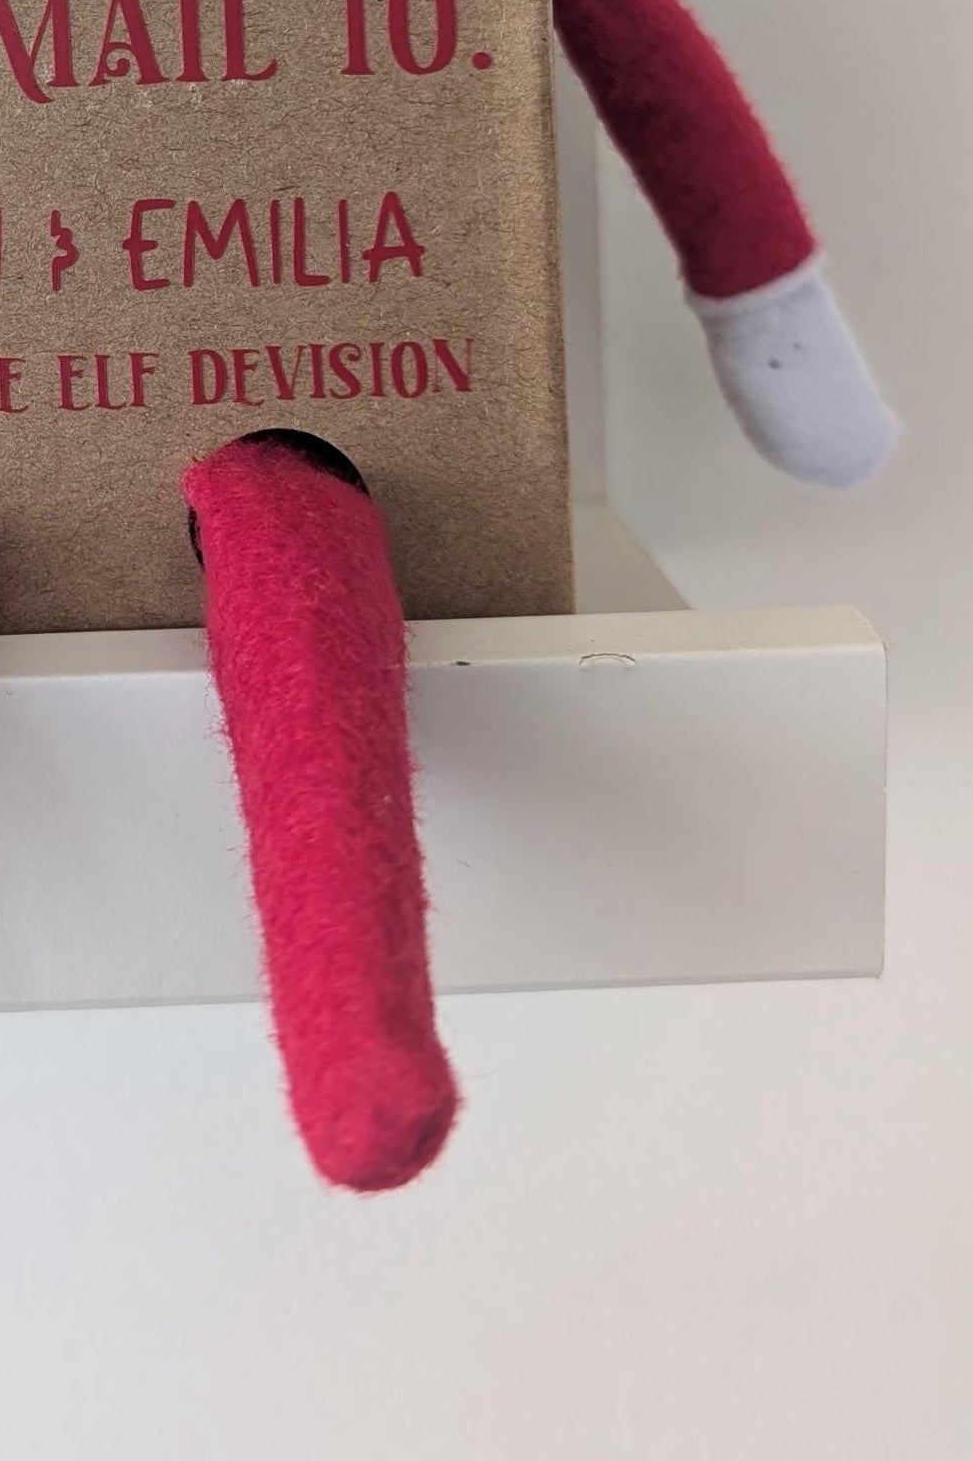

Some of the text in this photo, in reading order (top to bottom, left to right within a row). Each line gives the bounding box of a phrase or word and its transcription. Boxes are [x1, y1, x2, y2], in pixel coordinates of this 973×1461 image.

[122, 191, 426, 291] EMILIA
[57, 352, 157, 412] ELF
[187, 338, 475, 407] DEVISION
